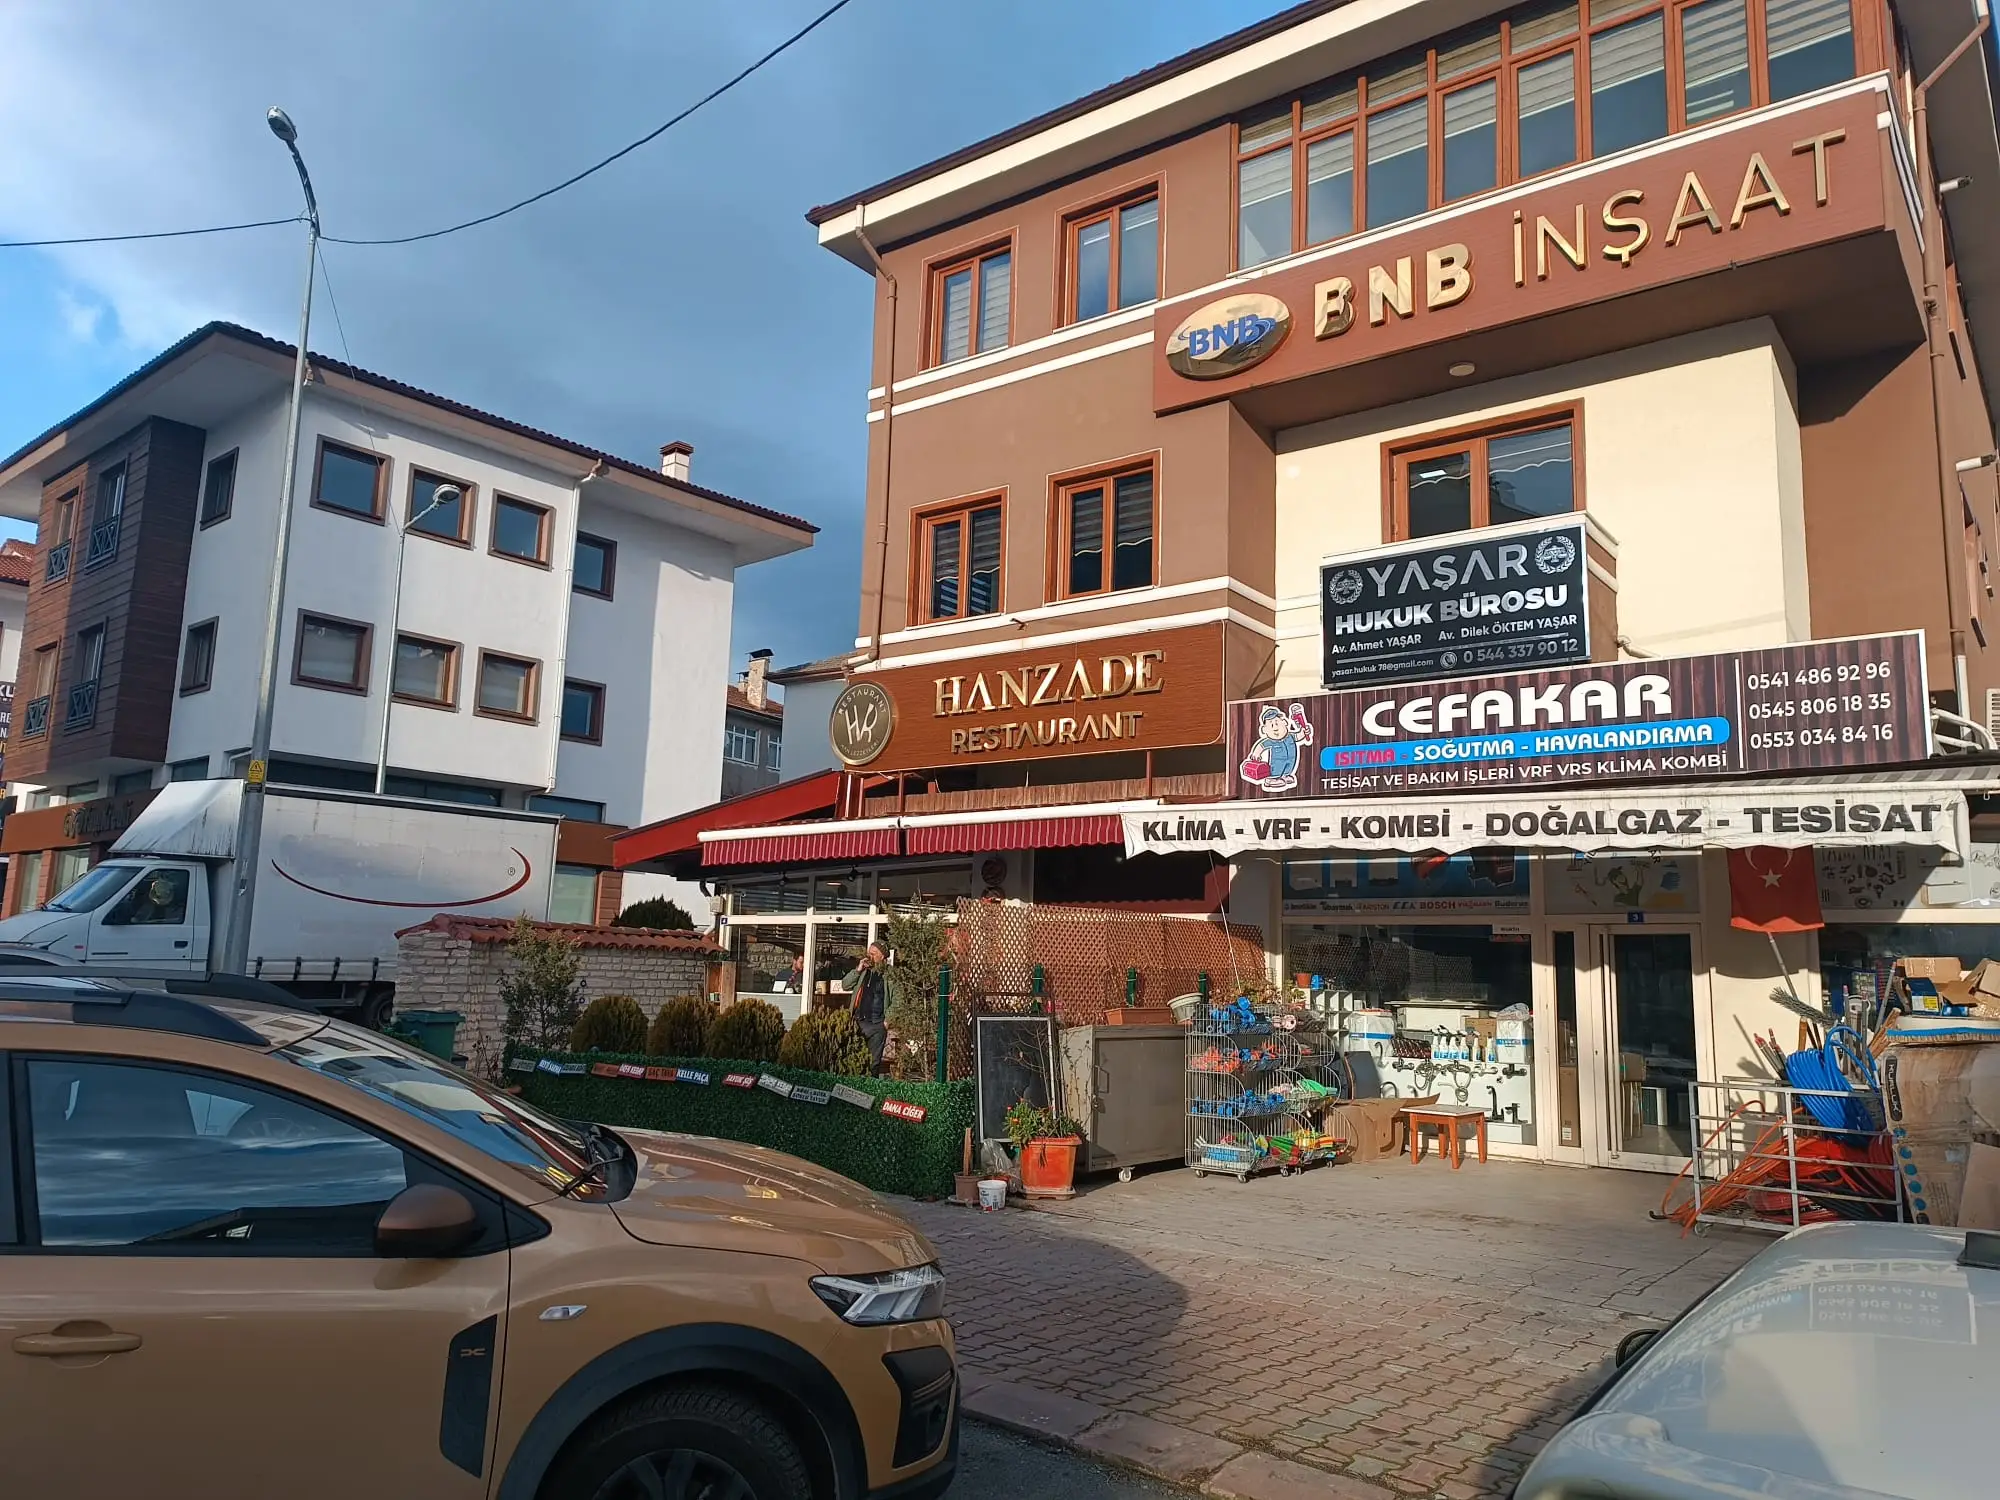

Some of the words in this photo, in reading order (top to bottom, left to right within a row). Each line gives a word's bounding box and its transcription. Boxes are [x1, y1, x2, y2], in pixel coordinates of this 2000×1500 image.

[1314, 243, 1474, 341] BNB
[1513, 128, 1846, 287] İNŞAAT
[1189, 313, 1262, 357] BNB
[1367, 544, 1528, 598] YAŞAR
[1335, 602, 1433, 635] HUKUK
[1440, 584, 1568, 622] BÜROSU
[1332, 644, 1347, 654] Av.
[1350, 637, 1384, 652] Ahmet
[1386, 634, 1422, 648] YAŞAR
[1438, 630, 1455, 641] Av.
[1461, 624, 1490, 638] Dilek
[1492, 618, 1534, 635] ÖKTEM
[1536, 614, 1577, 630] YAŞAR
[1463, 650, 1471, 663] 0
[1477, 647, 1504, 663] 544
[1507, 643, 1534, 659] 337
[1537, 640, 1558, 656] 90
[1561, 638, 1579, 653] 12
[932, 650, 1165, 717] HANZADE
[1747, 671, 1789, 690] 0541
[1795, 667, 1832, 685] 486
[1837, 664, 1861, 682] 92
[1866, 661, 1891, 679] 96
[1362, 674, 1672, 737] CEFAKAR
[1749, 700, 1795, 719] 0545
[1800, 697, 1837, 715] 806
[1842, 694, 1862, 712] 18
[1867, 692, 1891, 710] 35
[951, 711, 1143, 753] RESTAURANT
[1335, 747, 1395, 767] ISITMA
[1413, 737, 1514, 762] SOĞUTMA
[1535, 724, 1713, 754] HAVALANDIRMA
[1750, 731, 1795, 749] 0553
[1800, 727, 1837, 746] 034
[1842, 724, 1868, 743] 84
[1872, 723, 1893, 741] 16
[1321, 773, 1381, 790] TESİSAT
[1384, 773, 1403, 787] VE
[1407, 769, 1460, 785] BAKIM
[1463, 763, 1515, 785] İŞLERİ
[1518, 763, 1553, 778] VRF
[1557, 761, 1592, 775] VRS
[1597, 755, 1656, 773] KLİMA
[1662, 750, 1728, 770] KOMBİ
[1142, 815, 1227, 841] KLİMA
[1253, 817, 1311, 840] VRF
[1340, 809, 1450, 839] KOMBİ
[1485, 804, 1703, 836] DOĞALGAZ
[1743, 798, 1941, 834] TESİSAT
[1420, 901, 1456, 909] BOSCH
[677, 1068, 694, 1080] KELLE
[693, 1071, 709, 1084] PAÇA
[882, 1101, 902, 1114] DANA
[902, 1105, 925, 1119] CİĞER
